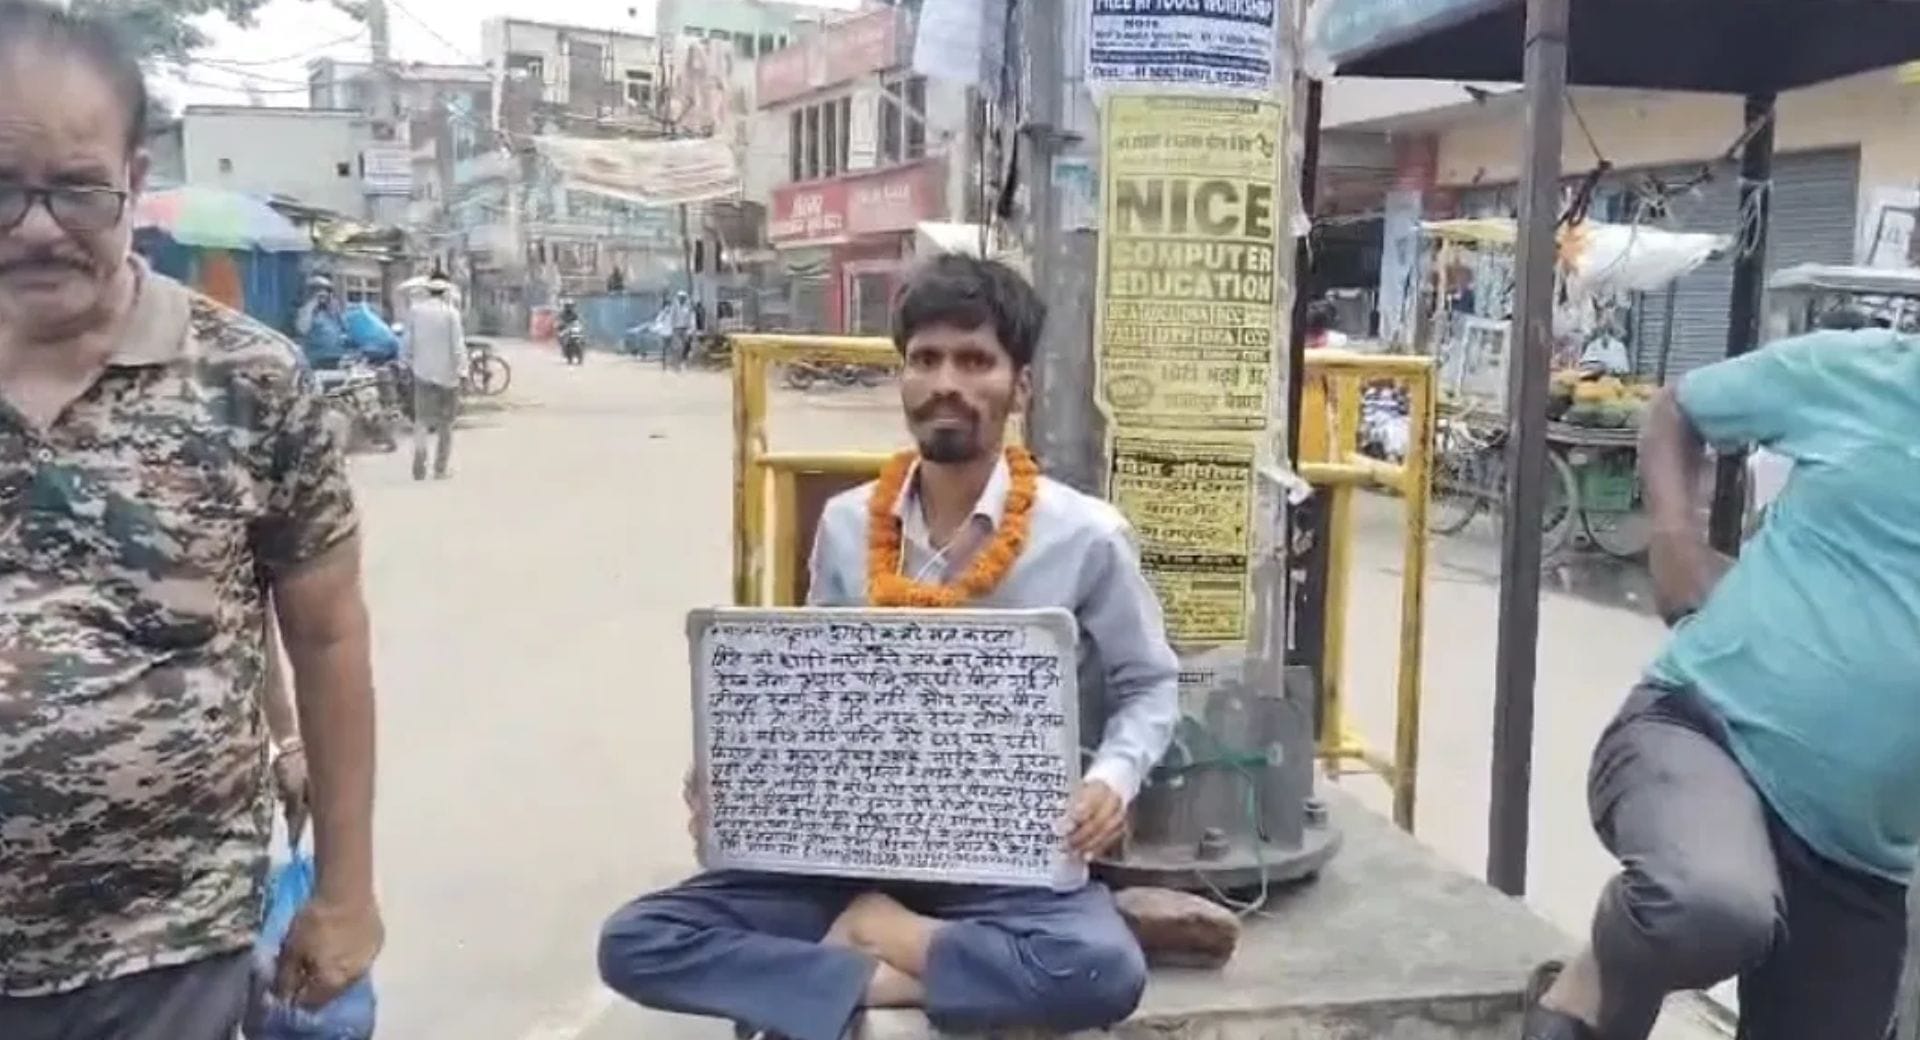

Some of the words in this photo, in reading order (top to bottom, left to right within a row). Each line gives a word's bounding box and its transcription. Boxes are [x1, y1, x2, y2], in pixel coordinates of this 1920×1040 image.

[1116, 180, 1272, 238] NICE
[1113, 241, 1272, 272] COMPUTER
[1110, 270, 1272, 301] EDUCATION
